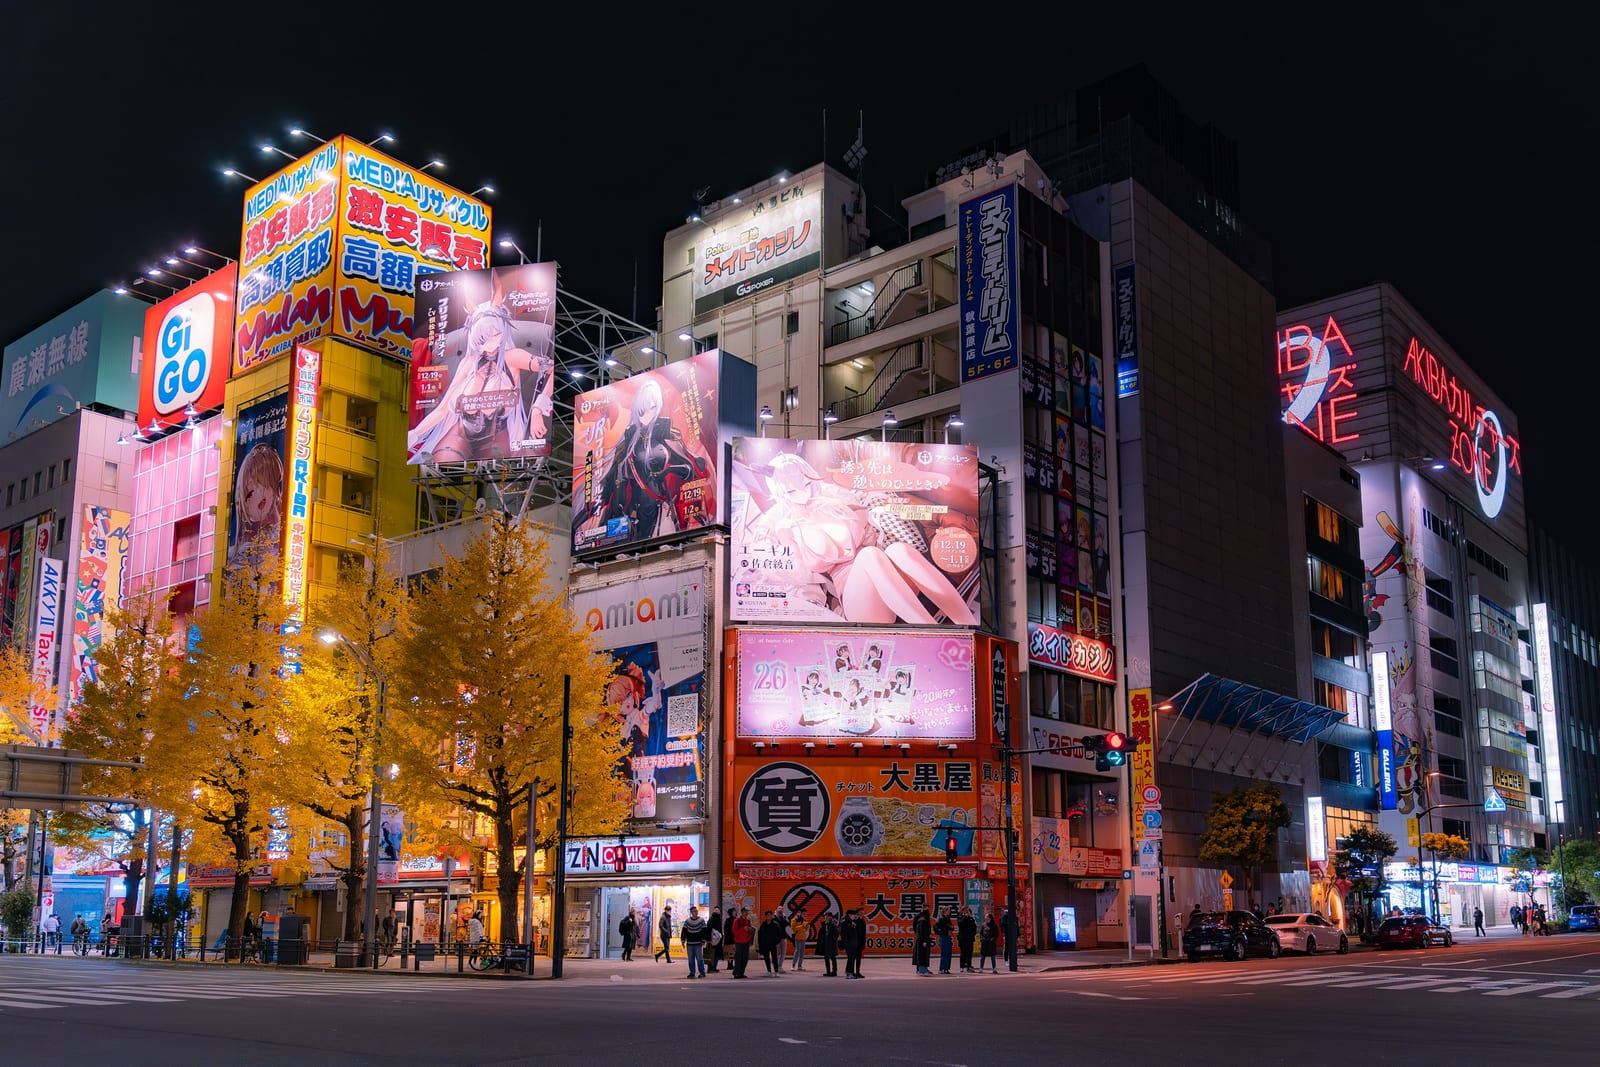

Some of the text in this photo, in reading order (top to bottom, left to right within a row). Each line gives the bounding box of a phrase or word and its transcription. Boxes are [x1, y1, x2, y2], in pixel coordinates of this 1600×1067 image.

[246, 144, 337, 224] MEDIAリサイクル
[349, 152, 488, 229] MEDIAリサイクル
[243, 181, 335, 264] 激安販売
[348, 185, 486, 270] 激安販売
[240, 228, 331, 314] 高額買取
[704, 219, 811, 285] メイドカジノ
[237, 285, 331, 366] Mulan
[340, 286, 415, 335] Mu
[162, 309, 191, 358] Gi
[353, 329, 398, 352] ムーラン
[399, 345, 413, 358] AK
[8, 320, 89, 397] 廣瀬無線
[158, 348, 206, 404] GO
[1038, 384, 1052, 406] 7F
[296, 407, 312, 460] ムーラン
[585, 414, 607, 446] UR
[292, 459, 309, 518] AKIBA
[840, 460, 893, 475] 誘う先は
[1039, 468, 1054, 489] 6F
[289, 521, 305, 617] 中央通りホビー
[739, 545, 794, 557] エーギル
[1041, 555, 1057, 576] 5F
[43, 562, 59, 616] AKKY
[585, 590, 689, 632] amiami
[1031, 628, 1114, 675] メイドカジノ
[754, 663, 788, 690] 20
[1131, 694, 1151, 745] 免税
[880, 762, 974, 793] 大黒屋
[1143, 750, 1152, 779] TAX
[1382, 749, 1391, 792] GALLERIA
[837, 782, 876, 792] チケット
[1145, 790, 1157, 799] 40
[751, 775, 819, 842] 質
[1147, 815, 1154, 828] P
[568, 843, 599, 870] ZIN
[603, 845, 671, 863] CMIC ZIN
[887, 879, 940, 891] チケット
[866, 894, 960, 921] 大黒屋
[866, 924, 960, 935] Daikoa
